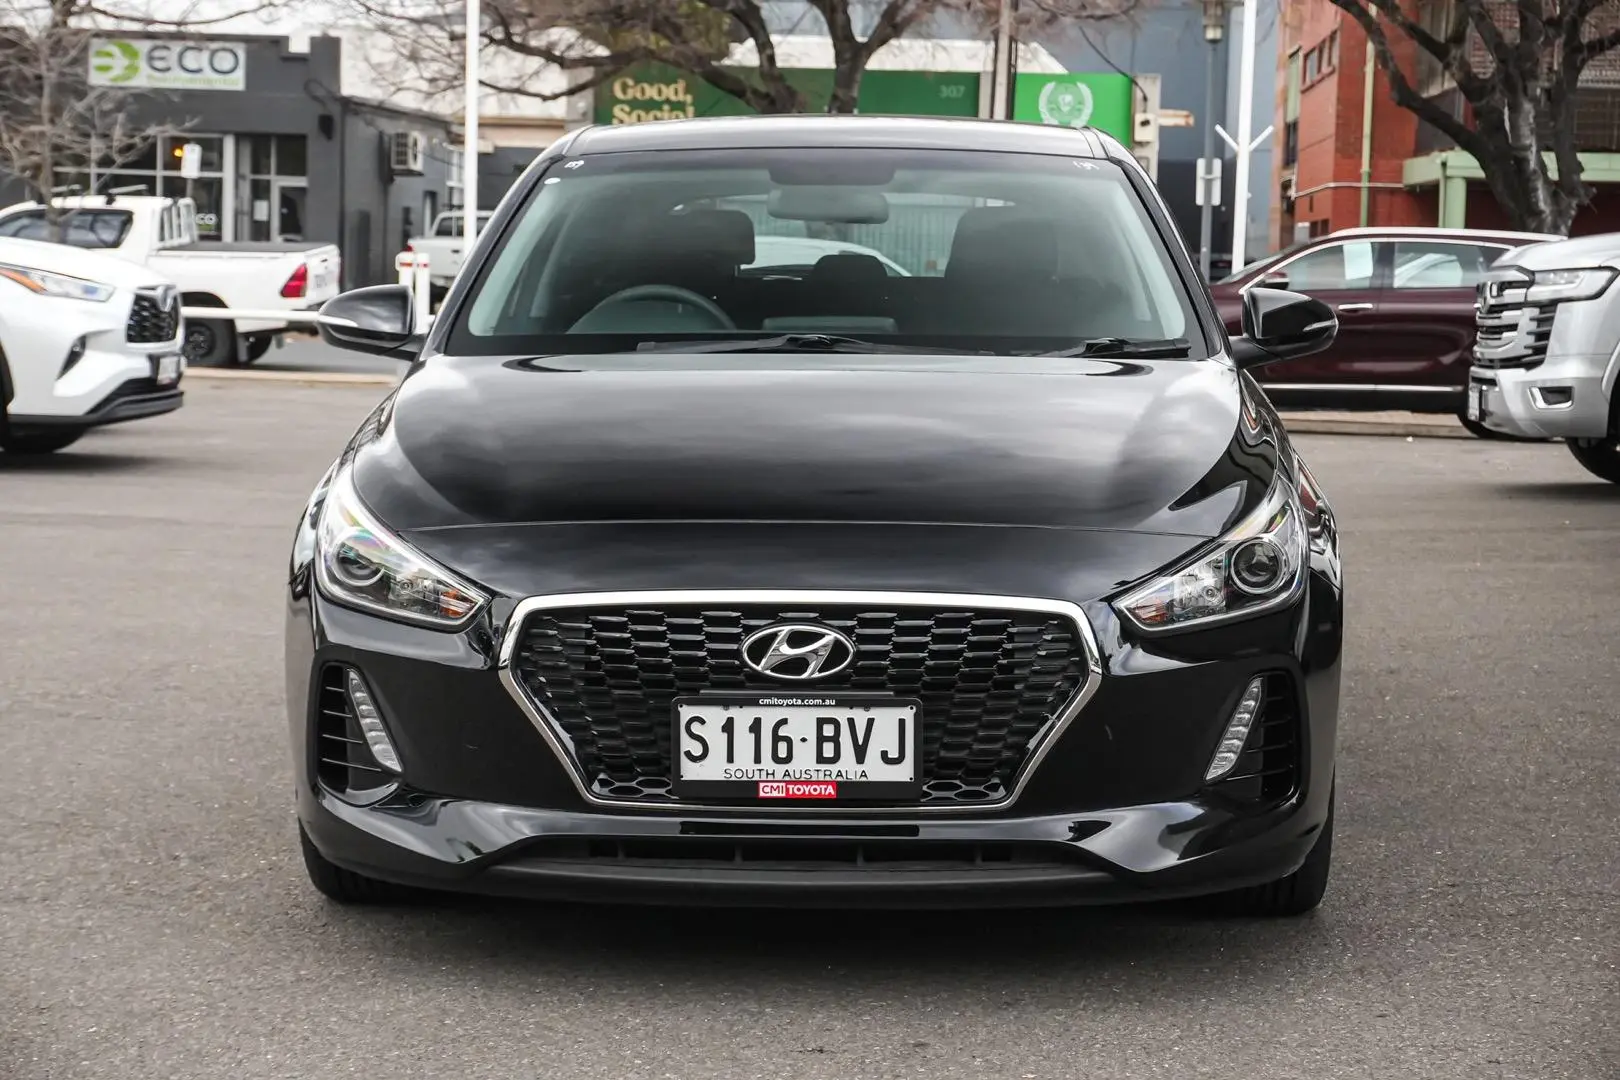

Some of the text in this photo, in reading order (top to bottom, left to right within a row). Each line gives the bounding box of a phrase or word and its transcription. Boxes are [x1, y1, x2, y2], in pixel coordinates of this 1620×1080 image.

[146, 44, 239, 75] ECO
[613, 78, 693, 105] Good,
[758, 697, 836, 707] cmitoyota.com.au
[723, 768, 869, 781] SOUTH AUSTRALIA
[761, 784, 835, 796] CMI TOYOTA
